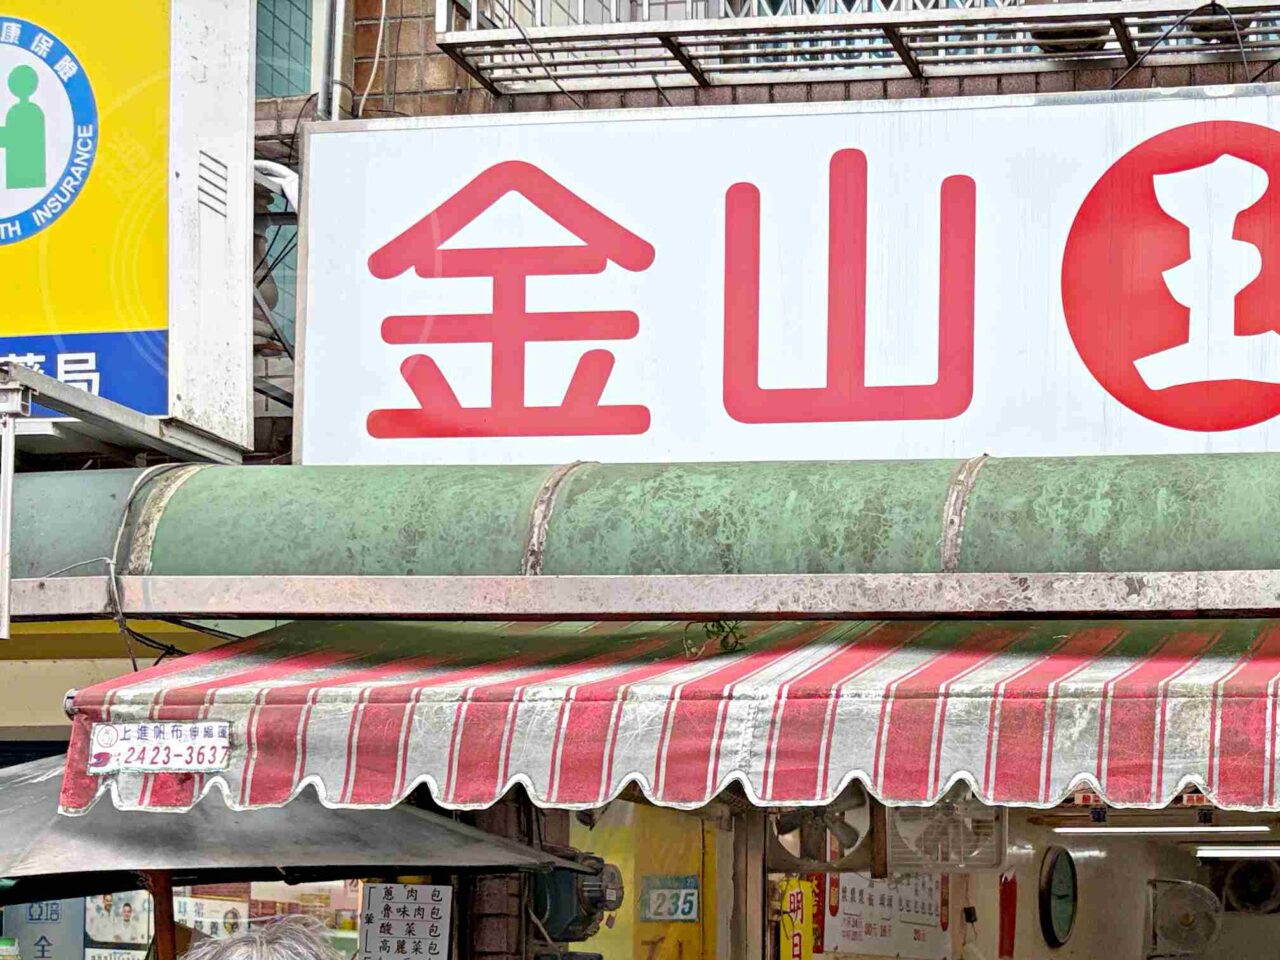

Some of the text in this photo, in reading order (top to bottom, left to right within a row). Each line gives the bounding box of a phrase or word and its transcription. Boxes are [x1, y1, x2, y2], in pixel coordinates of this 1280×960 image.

[32, 124, 94, 226] INSURANCE
[653, 891, 695, 917] 235
[380, 906, 443, 921] 魯味肉包
[379, 923, 441, 938] 酸菜包
[378, 940, 440, 956] 高麗菜包
